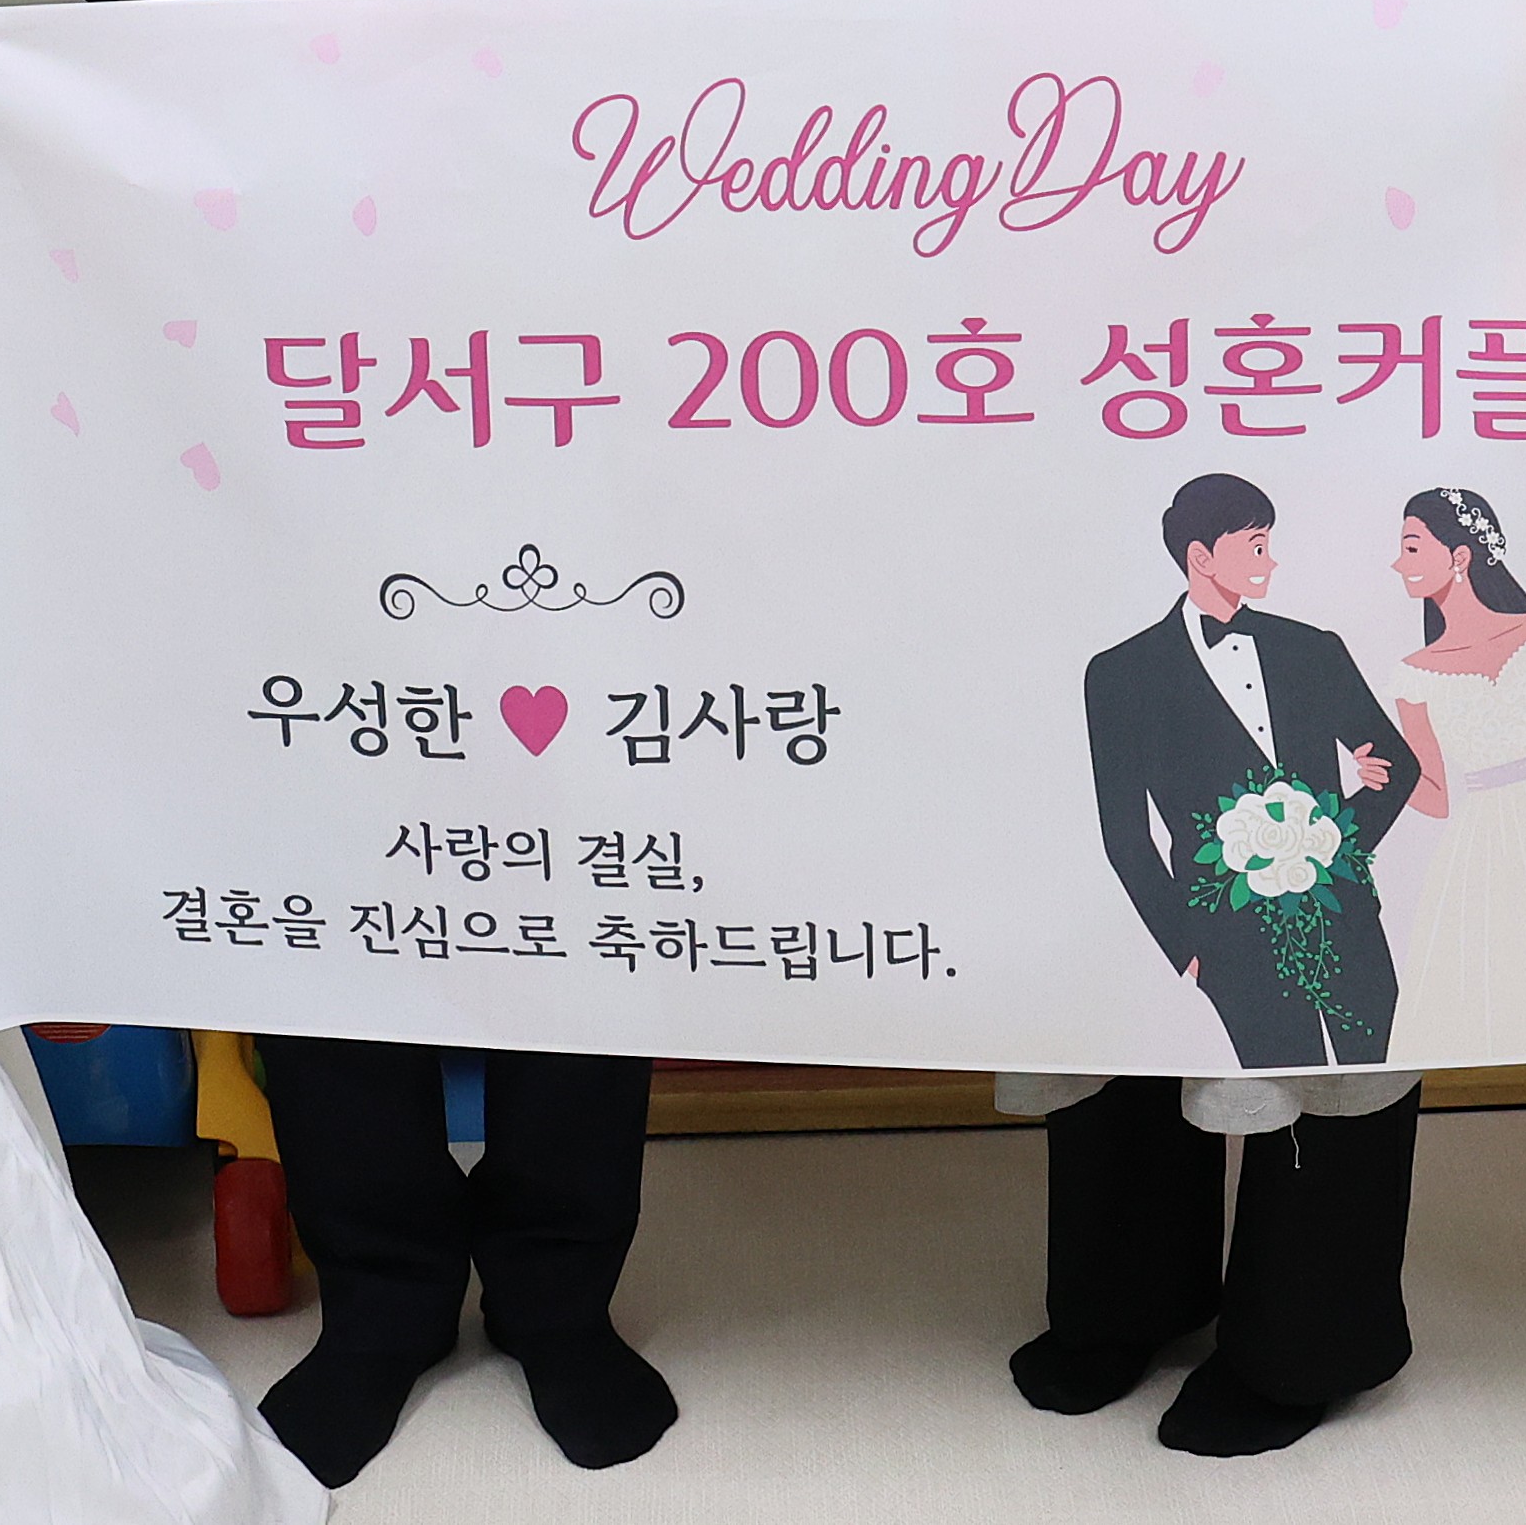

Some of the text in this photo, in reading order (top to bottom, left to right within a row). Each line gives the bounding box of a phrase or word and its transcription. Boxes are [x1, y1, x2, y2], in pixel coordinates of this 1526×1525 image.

[573, 72, 1246, 258] Wedding Day
[264, 330, 621, 450] 달서구
[667, 317, 1036, 429] 200호
[247, 675, 841, 767] 우성한 김사랑
[385, 821, 705, 893] 사랑의 결실,
[162, 886, 957, 981] 결혼을 진심으로 축하드립니다.
